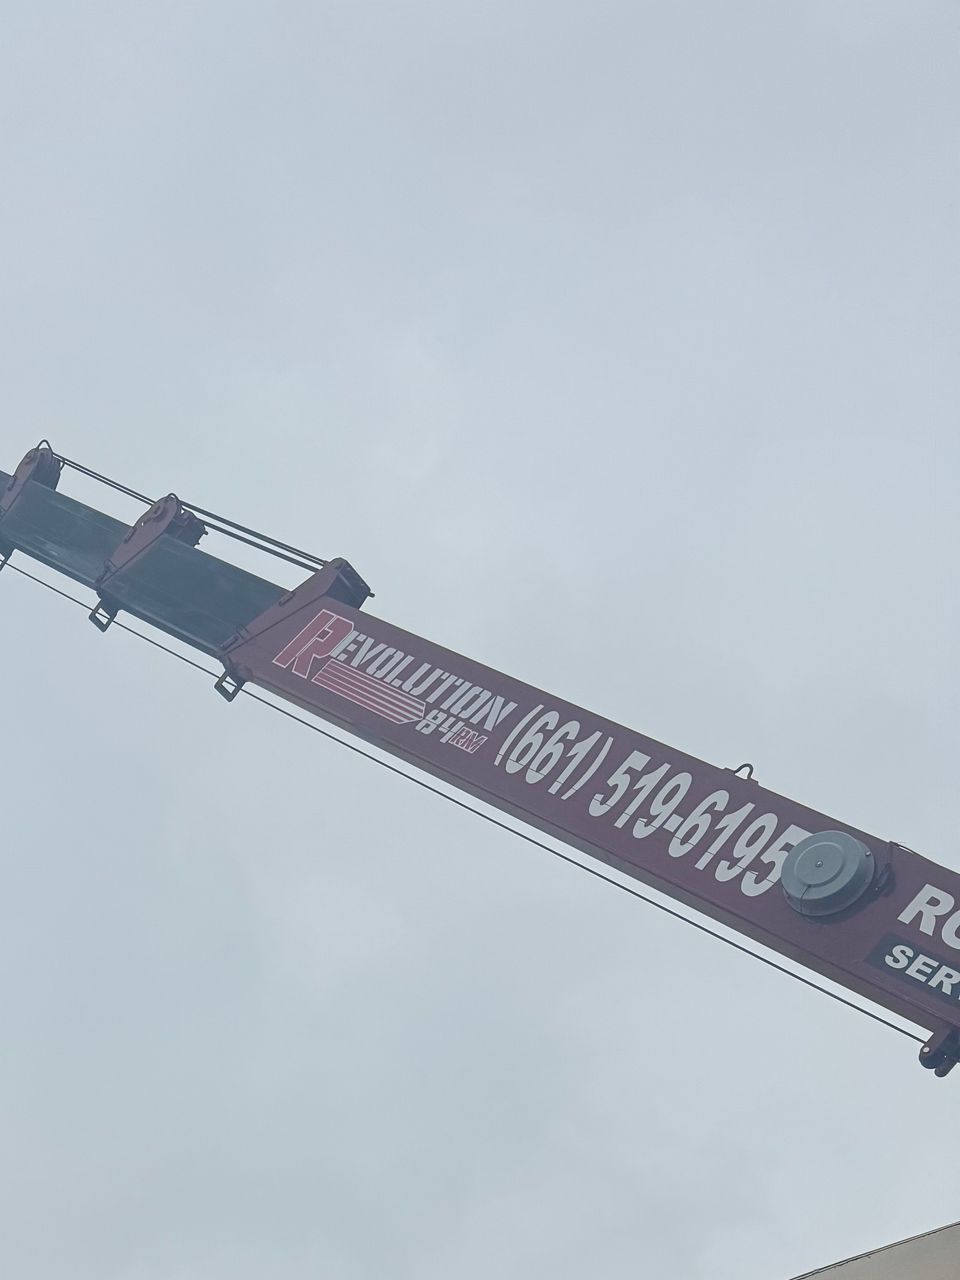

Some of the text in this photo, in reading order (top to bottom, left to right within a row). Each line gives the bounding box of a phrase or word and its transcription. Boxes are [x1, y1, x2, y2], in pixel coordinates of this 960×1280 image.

[272, 609, 518, 732] REVOLUTION
[494, 704, 813, 897] (661) 519-6195
[884, 944, 960, 1001] SER
